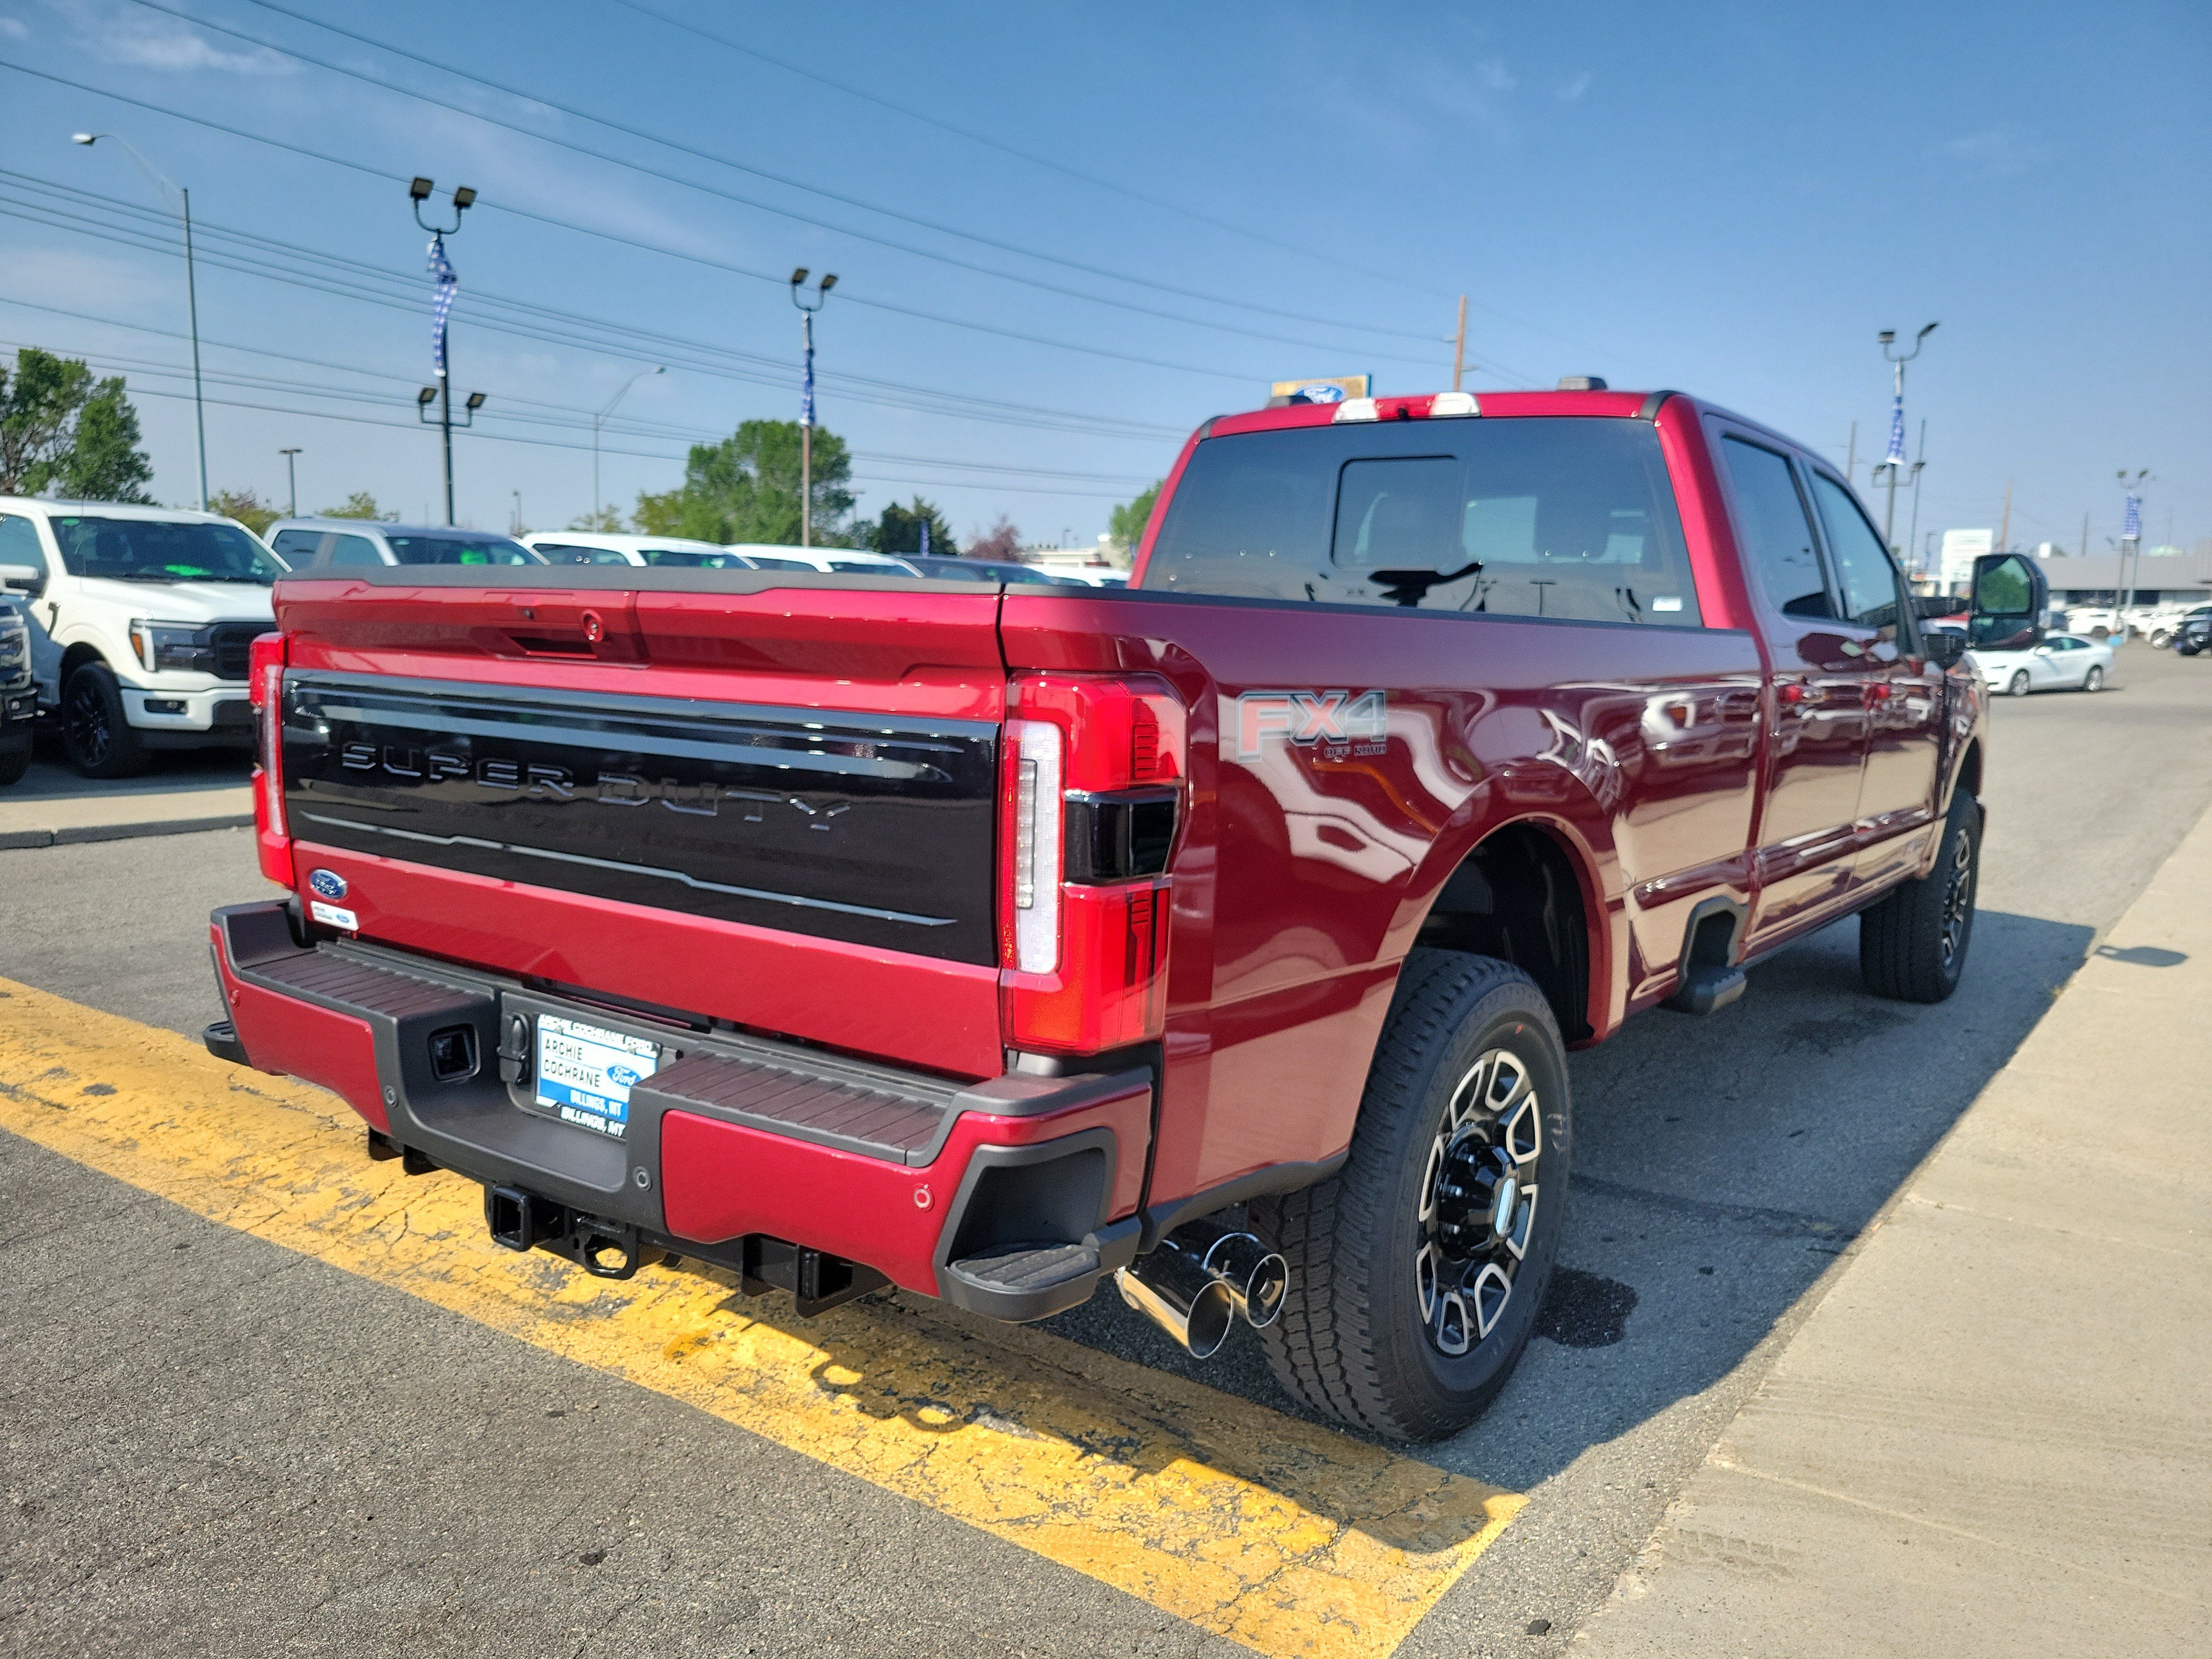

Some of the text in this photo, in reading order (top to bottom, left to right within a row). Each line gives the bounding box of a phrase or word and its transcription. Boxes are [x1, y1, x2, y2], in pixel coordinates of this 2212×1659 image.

[1235, 689, 1387, 763] FX4
[342, 740, 851, 831] SUPER DUTY
[572, 1022, 625, 1044] COCHRANE
[544, 1038, 583, 1060] ARCHIE
[544, 1059, 601, 1087] COCHRANE
[612, 1066, 637, 1086] Ford
[570, 1089, 623, 1117] BILLINGS, MT
[561, 1106, 626, 1137] BILLINGS, MT
